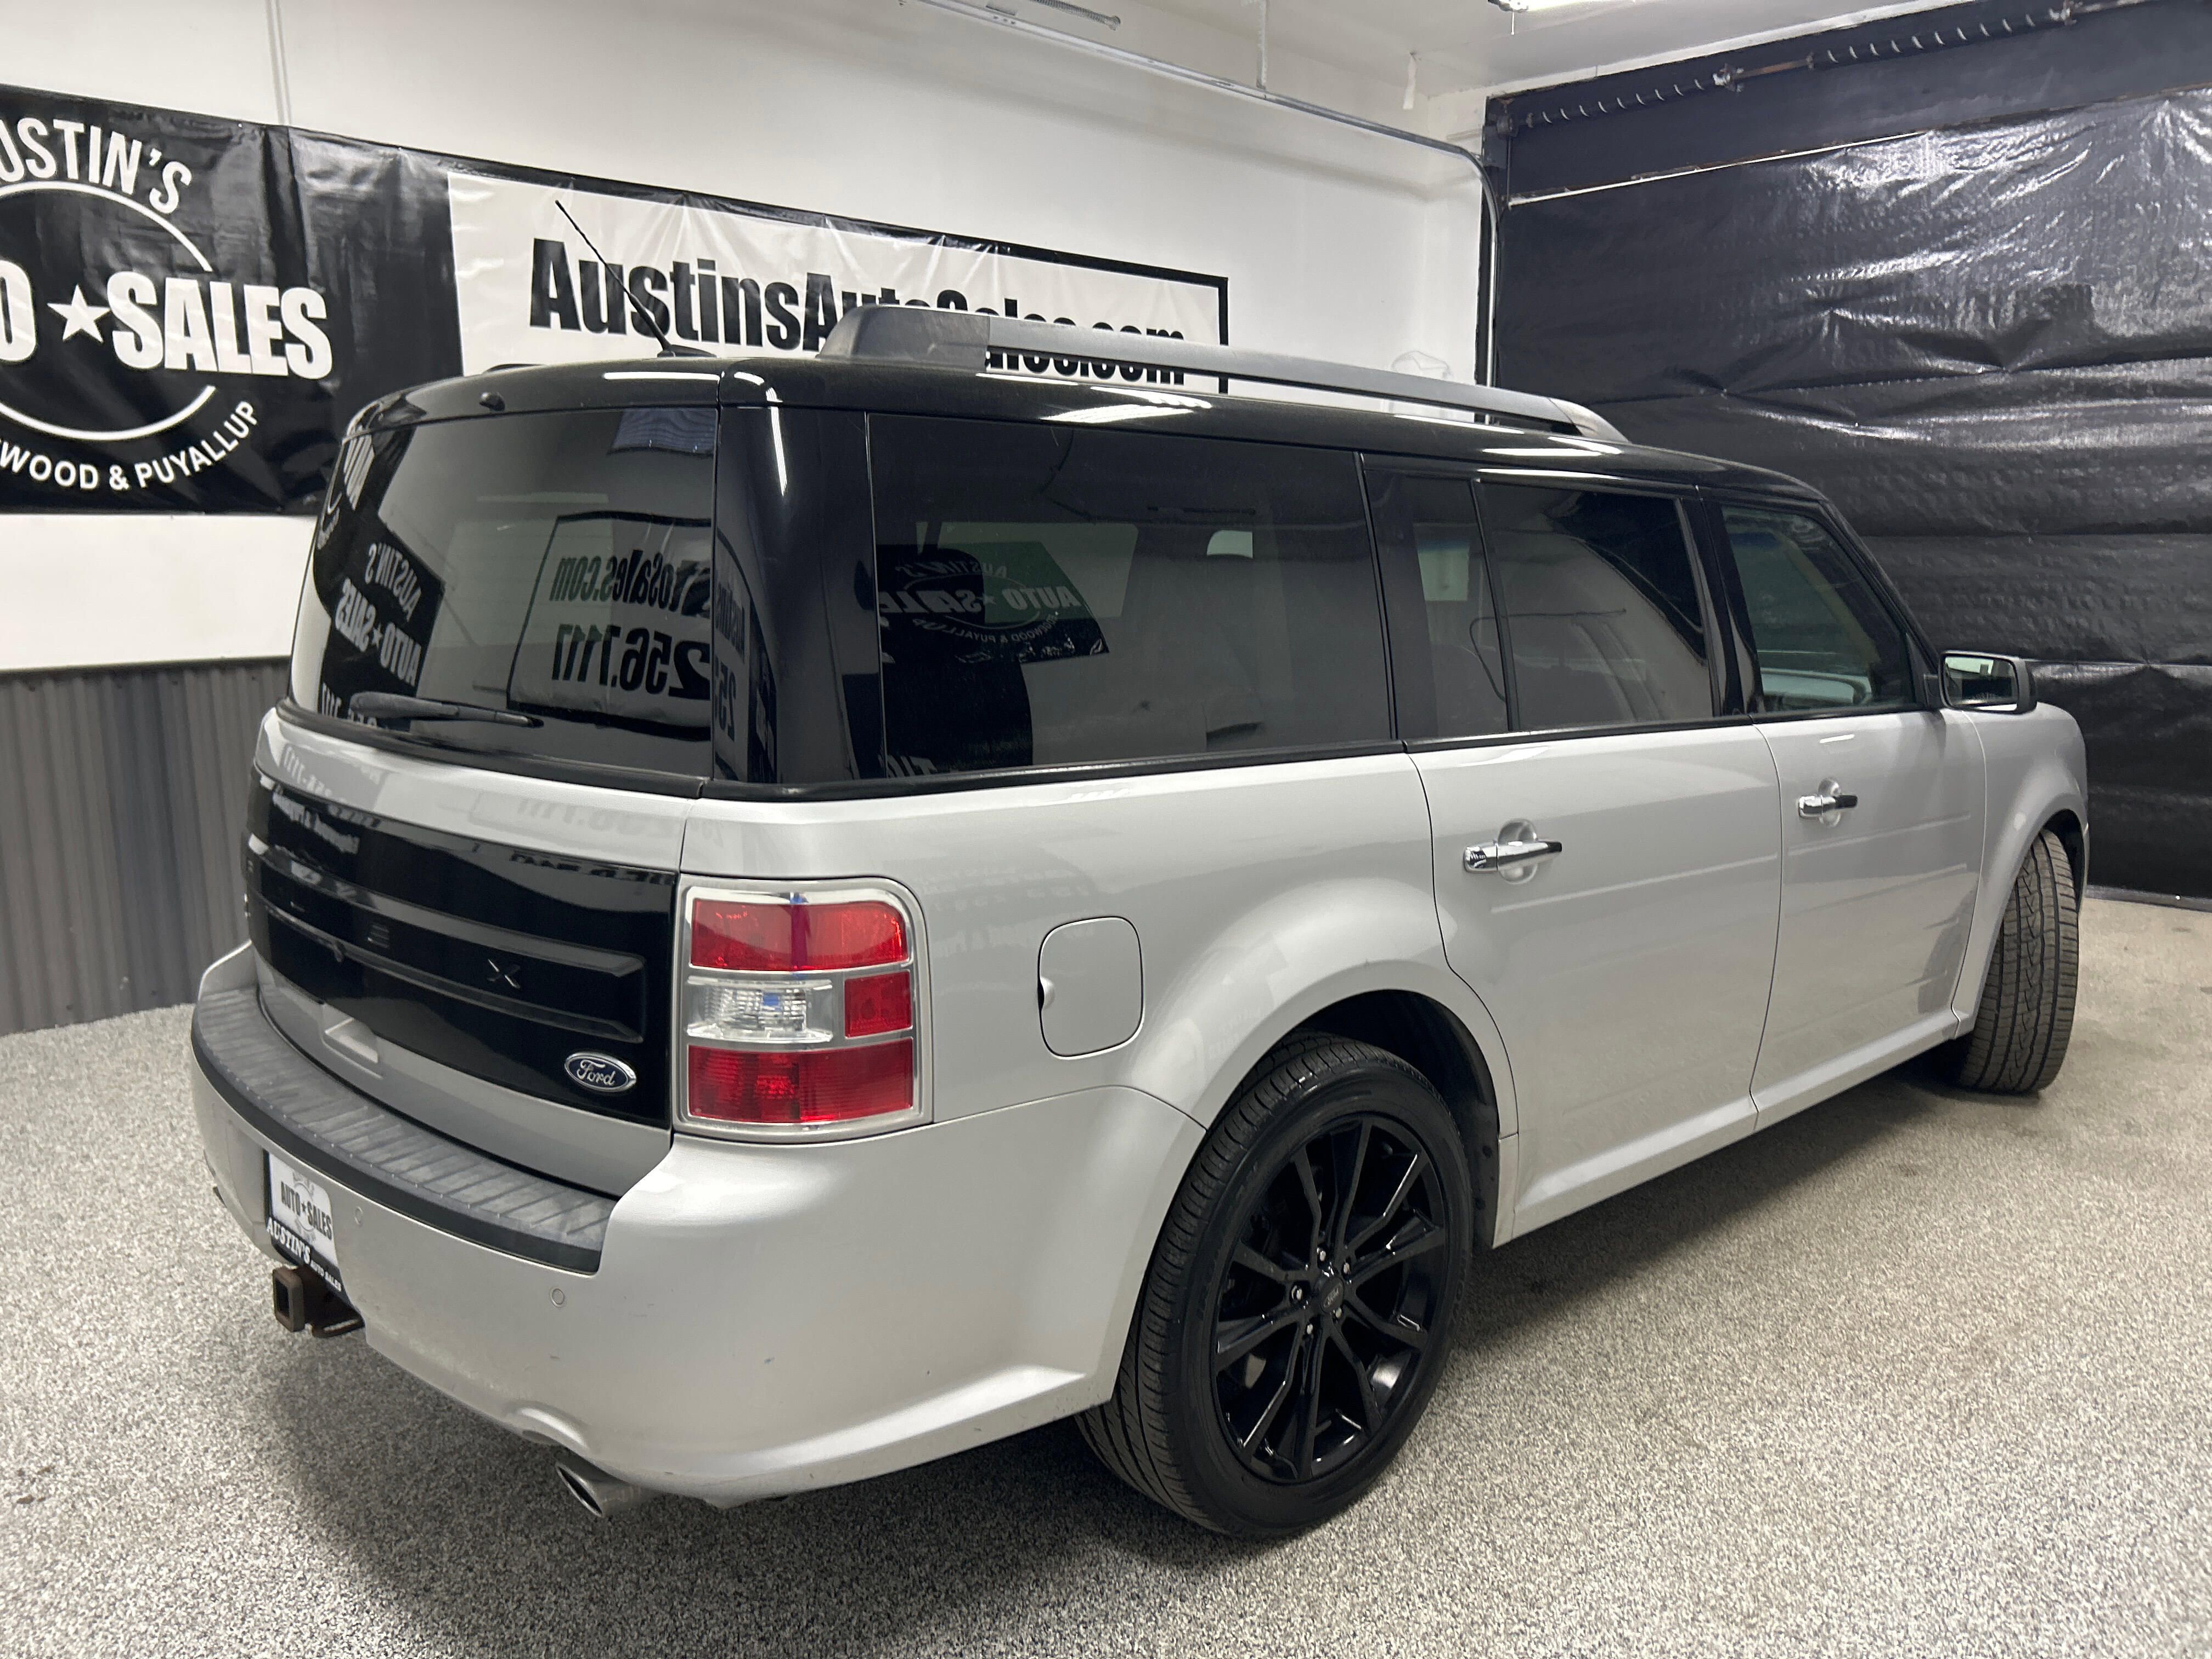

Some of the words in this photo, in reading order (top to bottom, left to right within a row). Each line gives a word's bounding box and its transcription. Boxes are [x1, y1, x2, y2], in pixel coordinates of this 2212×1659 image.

[107, 271, 333, 380] SALES
[109, 464, 130, 491] &
[134, 400, 257, 488] PUYALLUP
[577, 1059, 616, 1086] Ford
[280, 1180, 301, 1217] AUTO
[307, 1200, 332, 1241] SALES
